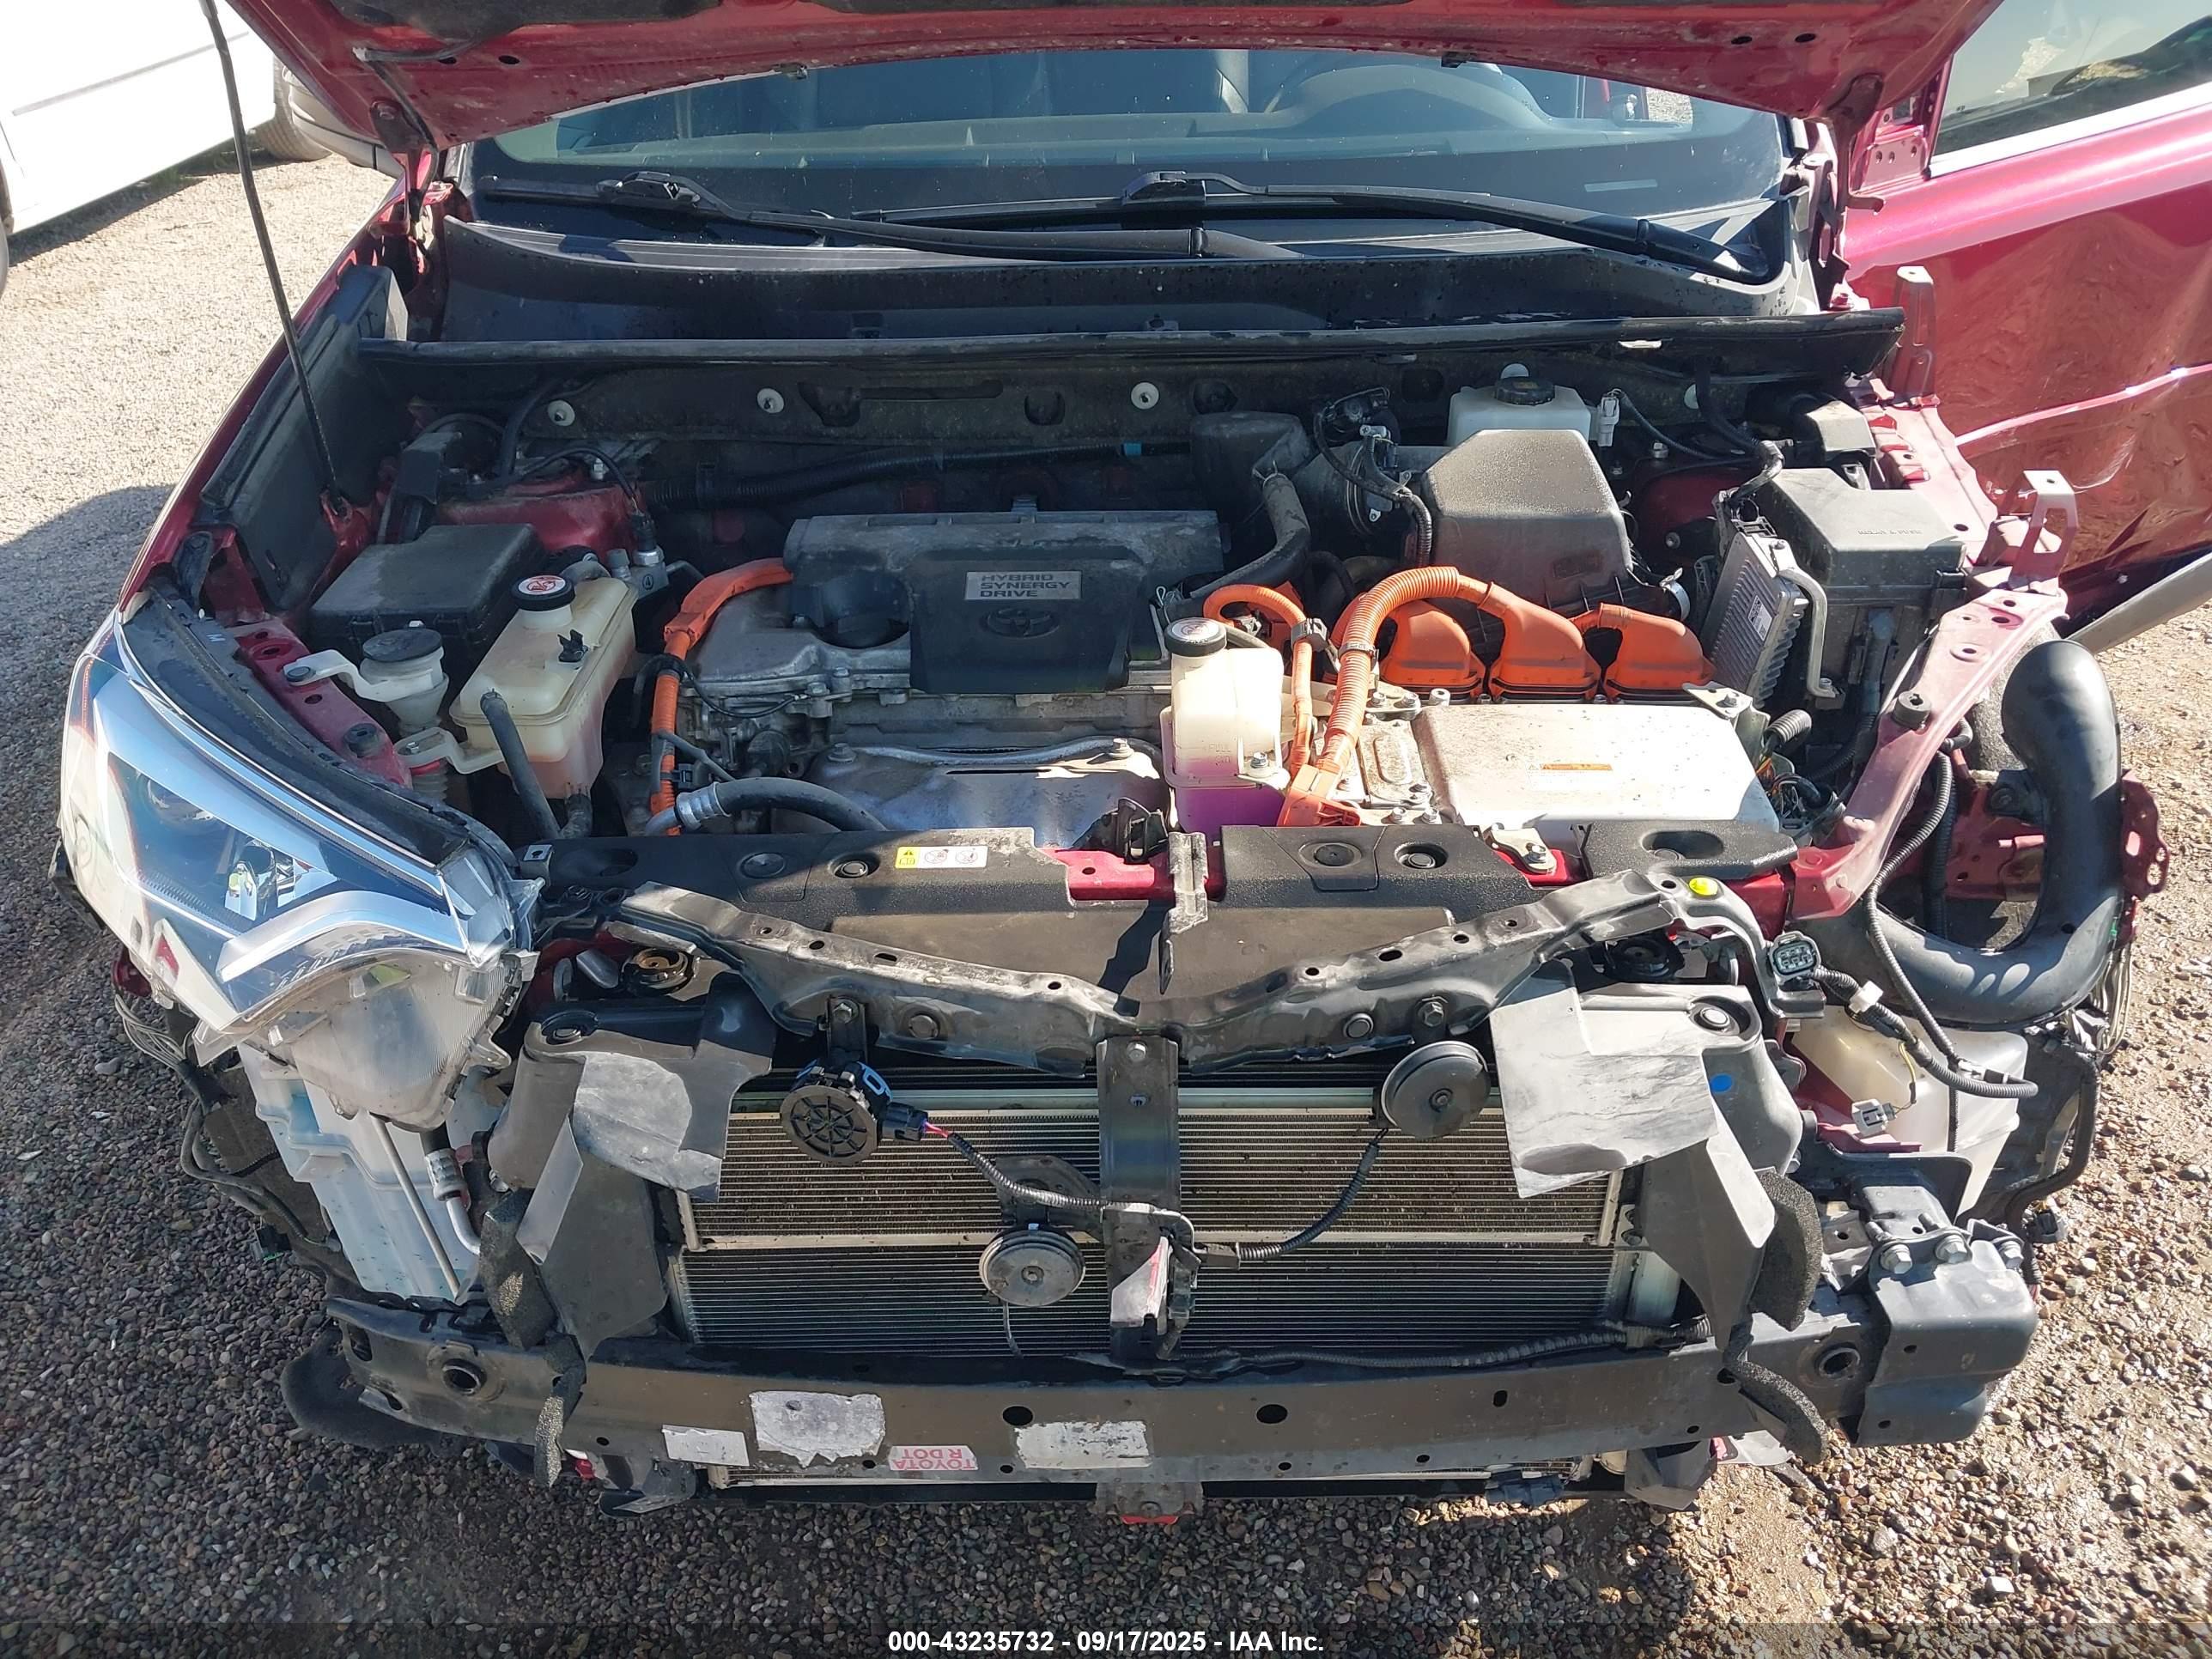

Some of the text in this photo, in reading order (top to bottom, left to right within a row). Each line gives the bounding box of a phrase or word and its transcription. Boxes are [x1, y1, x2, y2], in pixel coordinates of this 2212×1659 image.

[980, 581, 1070, 590] SYNERGY
[902, 1448, 962, 1459] R DOT
[892, 1458, 975, 1470] TOYOTA
